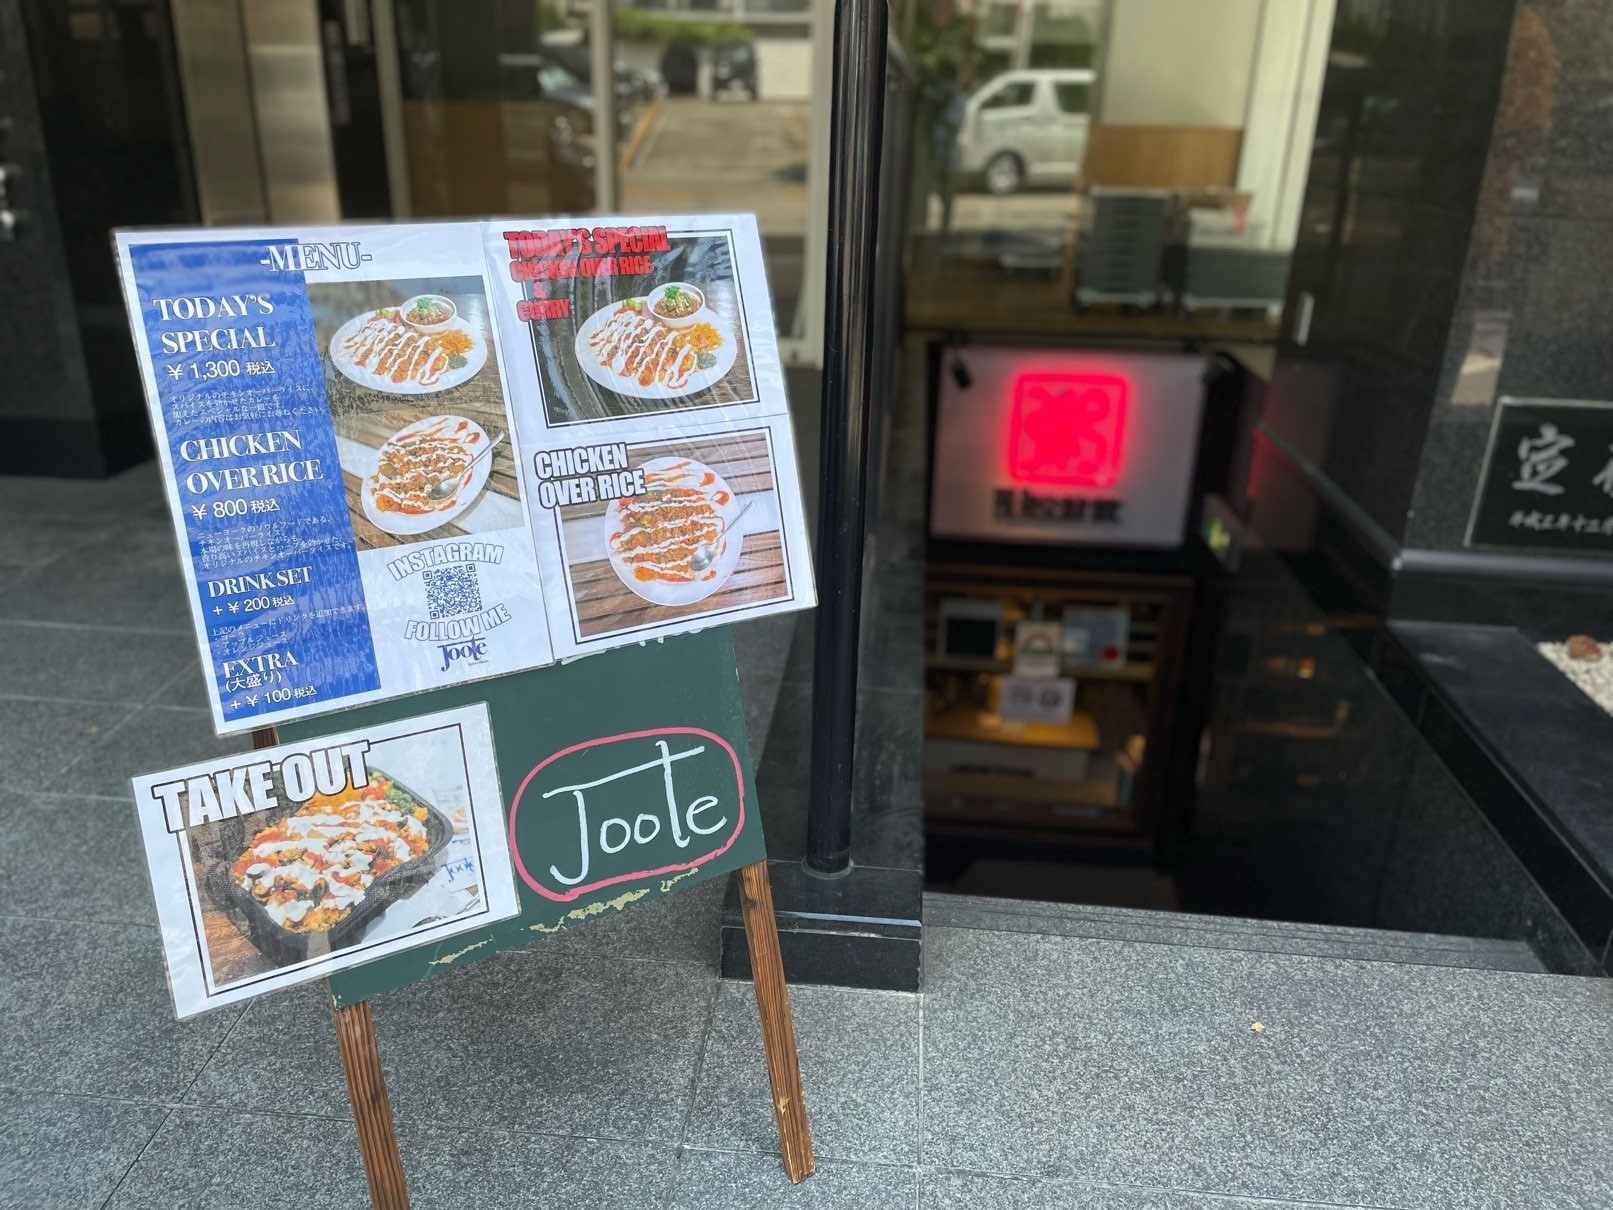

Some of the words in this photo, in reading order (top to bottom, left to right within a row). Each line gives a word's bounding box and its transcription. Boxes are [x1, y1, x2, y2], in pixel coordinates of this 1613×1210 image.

[503, 228, 592, 259] TODAY'S
[591, 225, 671, 255] SPECIAL
[509, 258, 578, 282] CHICKEN
[580, 256, 618, 278] OVER
[620, 255, 654, 276] RICE
[533, 280, 547, 299] &
[153, 294, 274, 321] TODAY'S
[516, 298, 570, 322] CURRY
[161, 327, 275, 354] SPECIAL
[246, 362, 276, 376] 税込
[180, 430, 302, 462] CHICKEN
[533, 442, 630, 480] CHICKEN
[186, 467, 264, 495] OVER
[262, 459, 324, 484] RICE
[538, 475, 598, 509] OVER
[597, 468, 647, 502] RICE
[250, 499, 281, 513] 税込
[387, 542, 504, 581] INSTAGRAM
[207, 571, 278, 598] DRINK
[278, 566, 313, 587] SET
[272, 595, 295, 608] 税込
[404, 615, 481, 642] FOLLOW
[480, 603, 512, 631] ME
[222, 650, 299, 679] EXTRA
[293, 685, 317, 699] 税込
[151, 760, 279, 834] TAKE
[280, 739, 370, 804] OUT
